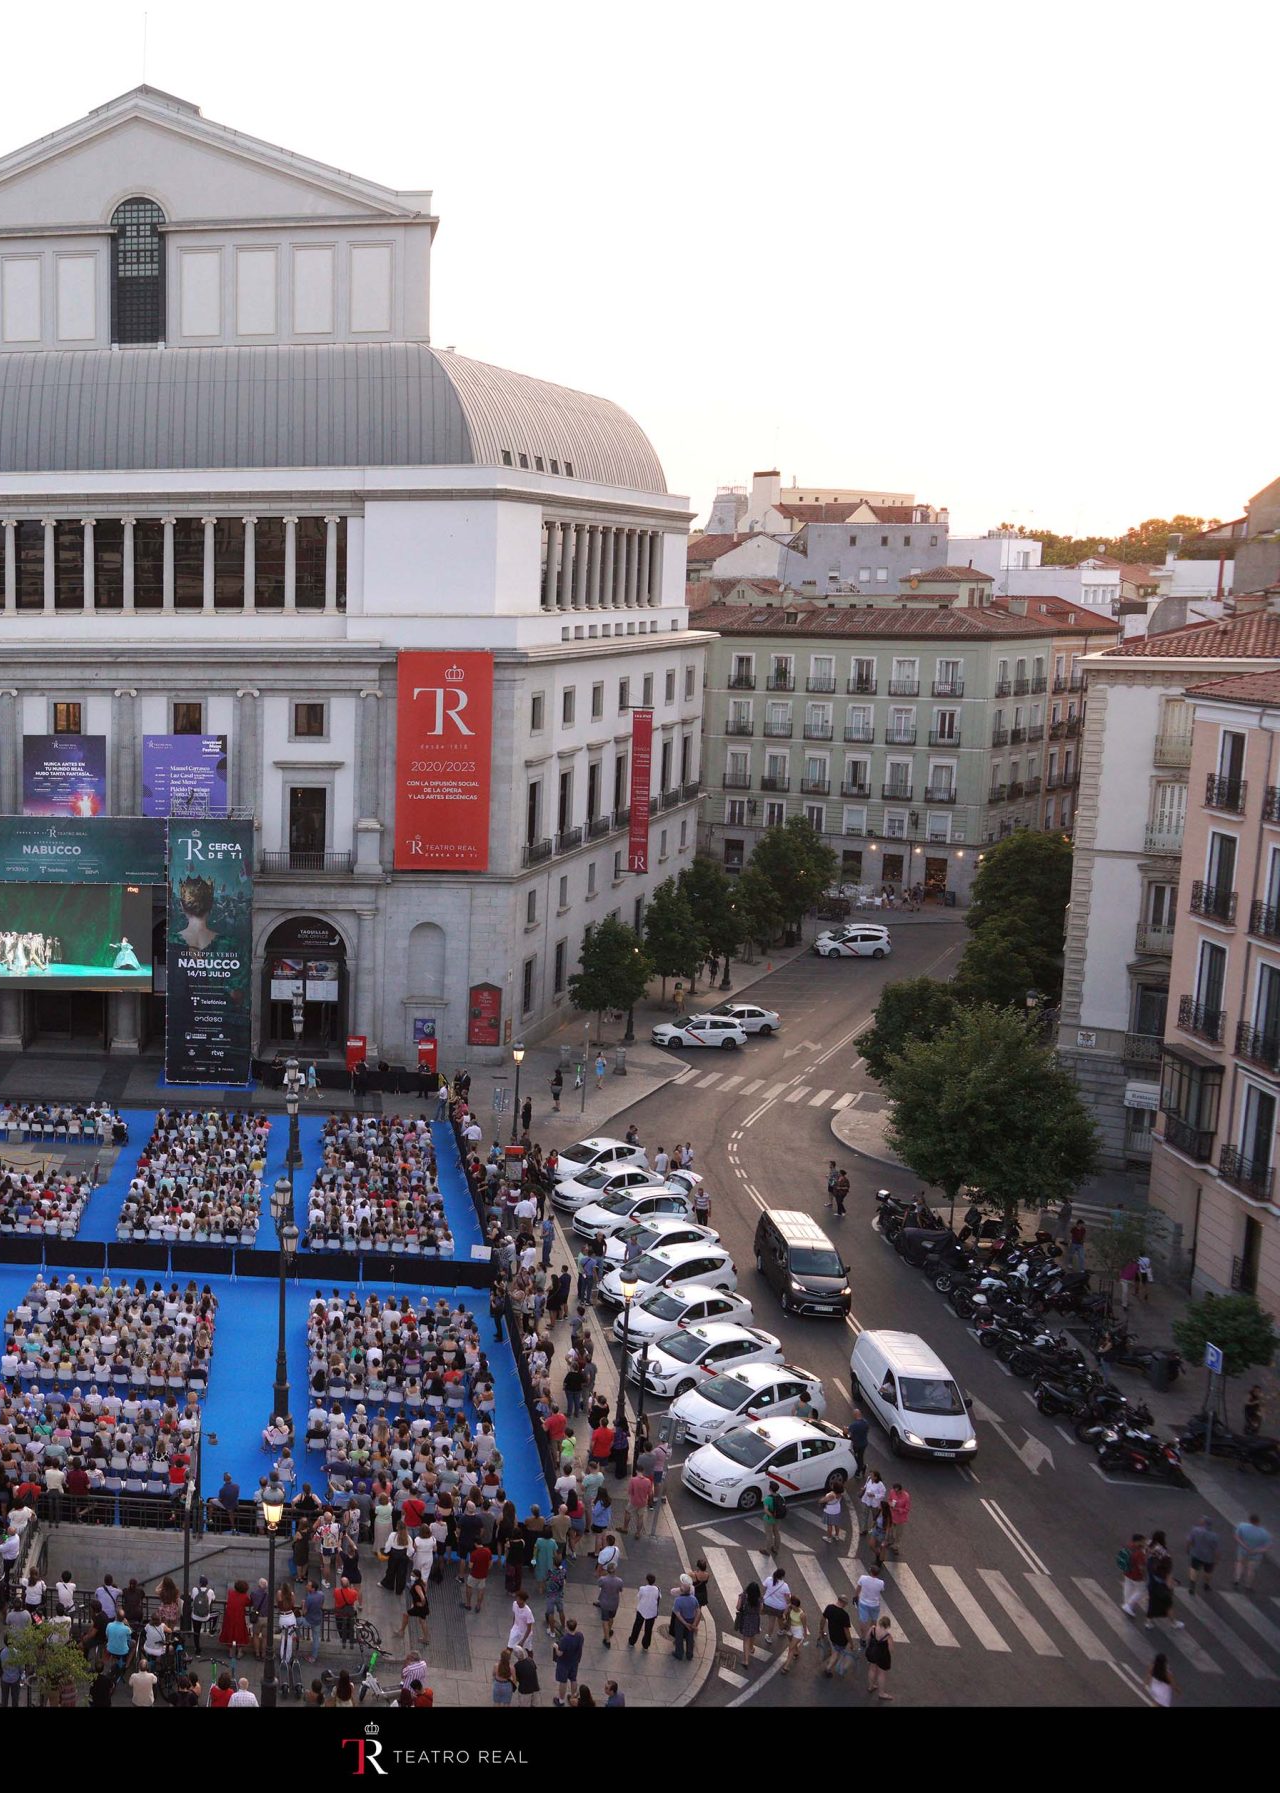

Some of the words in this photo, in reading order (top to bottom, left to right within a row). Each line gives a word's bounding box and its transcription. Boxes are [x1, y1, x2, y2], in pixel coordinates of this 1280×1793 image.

[413, 687, 476, 736] TR
[411, 761, 476, 772] 2020/2023
[23, 845, 81, 855] NABUCCO
[178, 839, 206, 860] TR
[178, 959, 240, 969] NABUCCO
